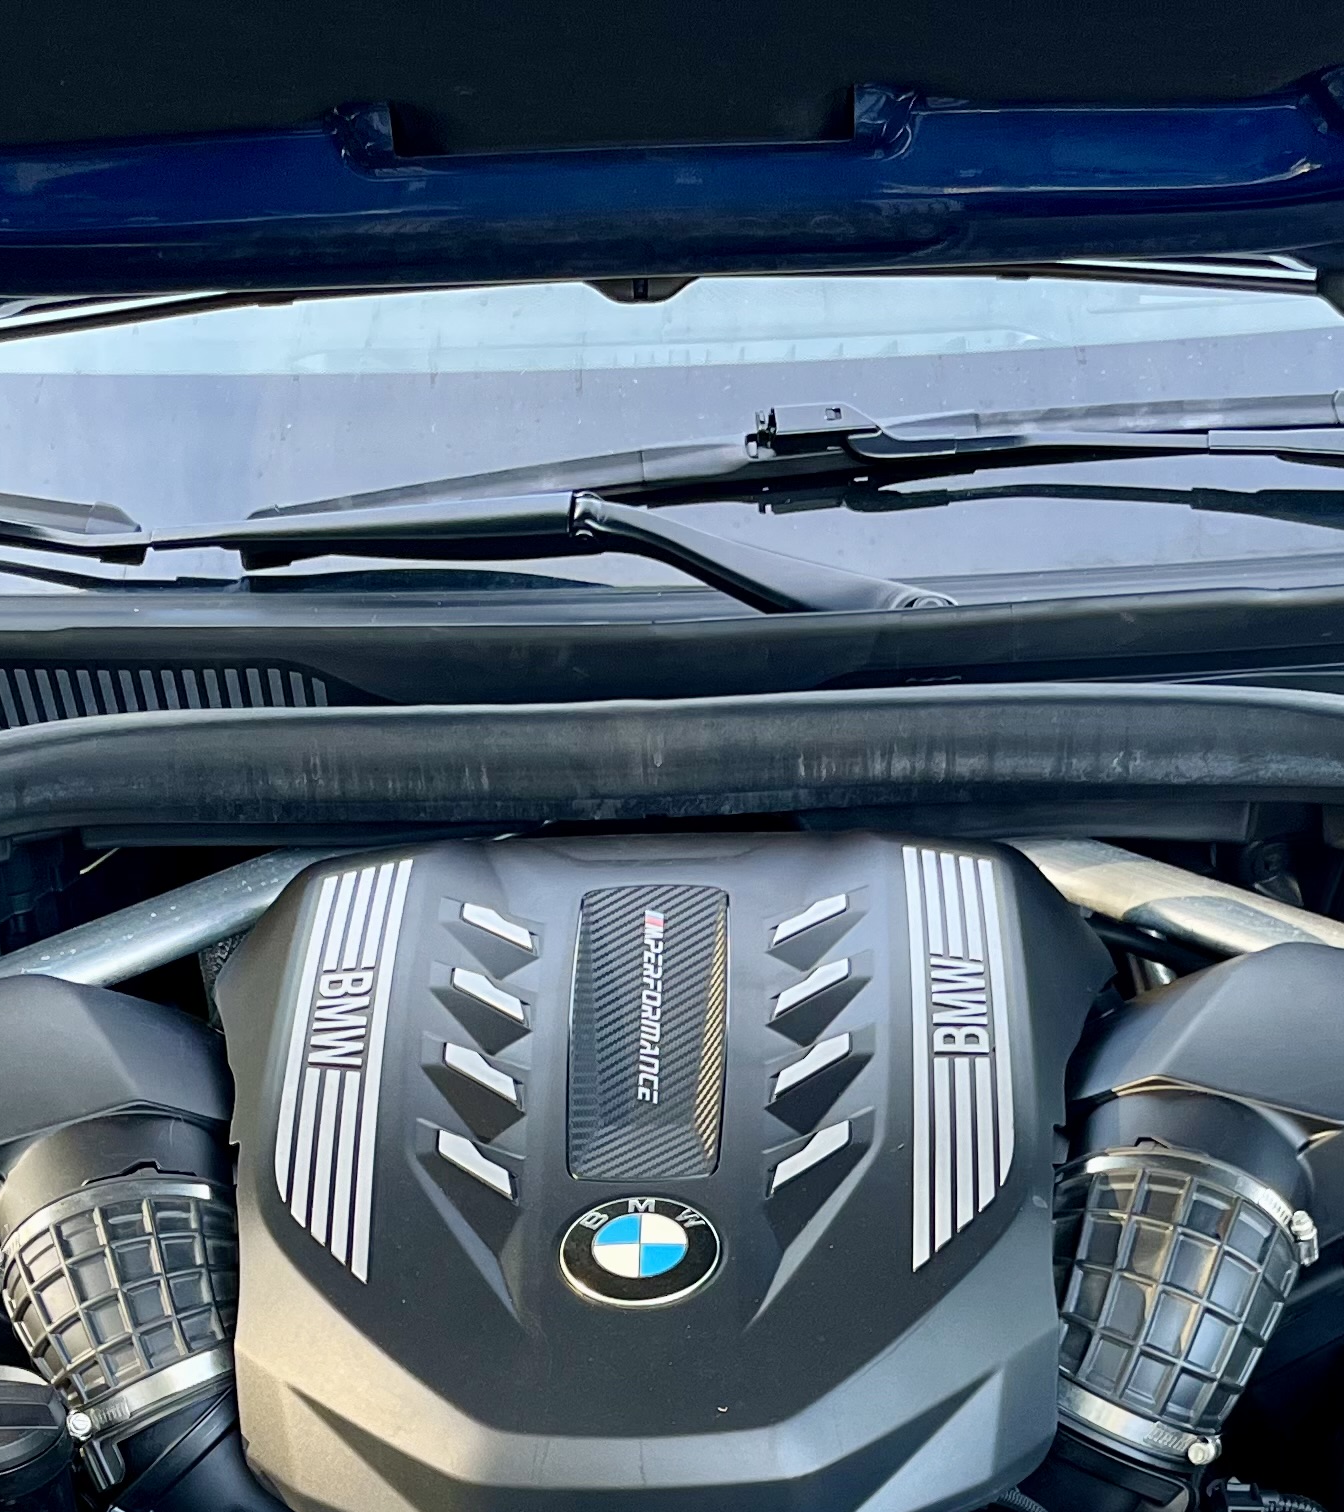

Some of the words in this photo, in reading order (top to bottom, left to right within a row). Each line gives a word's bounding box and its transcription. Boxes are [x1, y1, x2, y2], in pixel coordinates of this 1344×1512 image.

[307, 971, 374, 1067] BMW
[637, 938, 664, 1104] PERFORMANCE
[930, 958, 990, 1053] BMW
[580, 1199, 706, 1231] BMW
